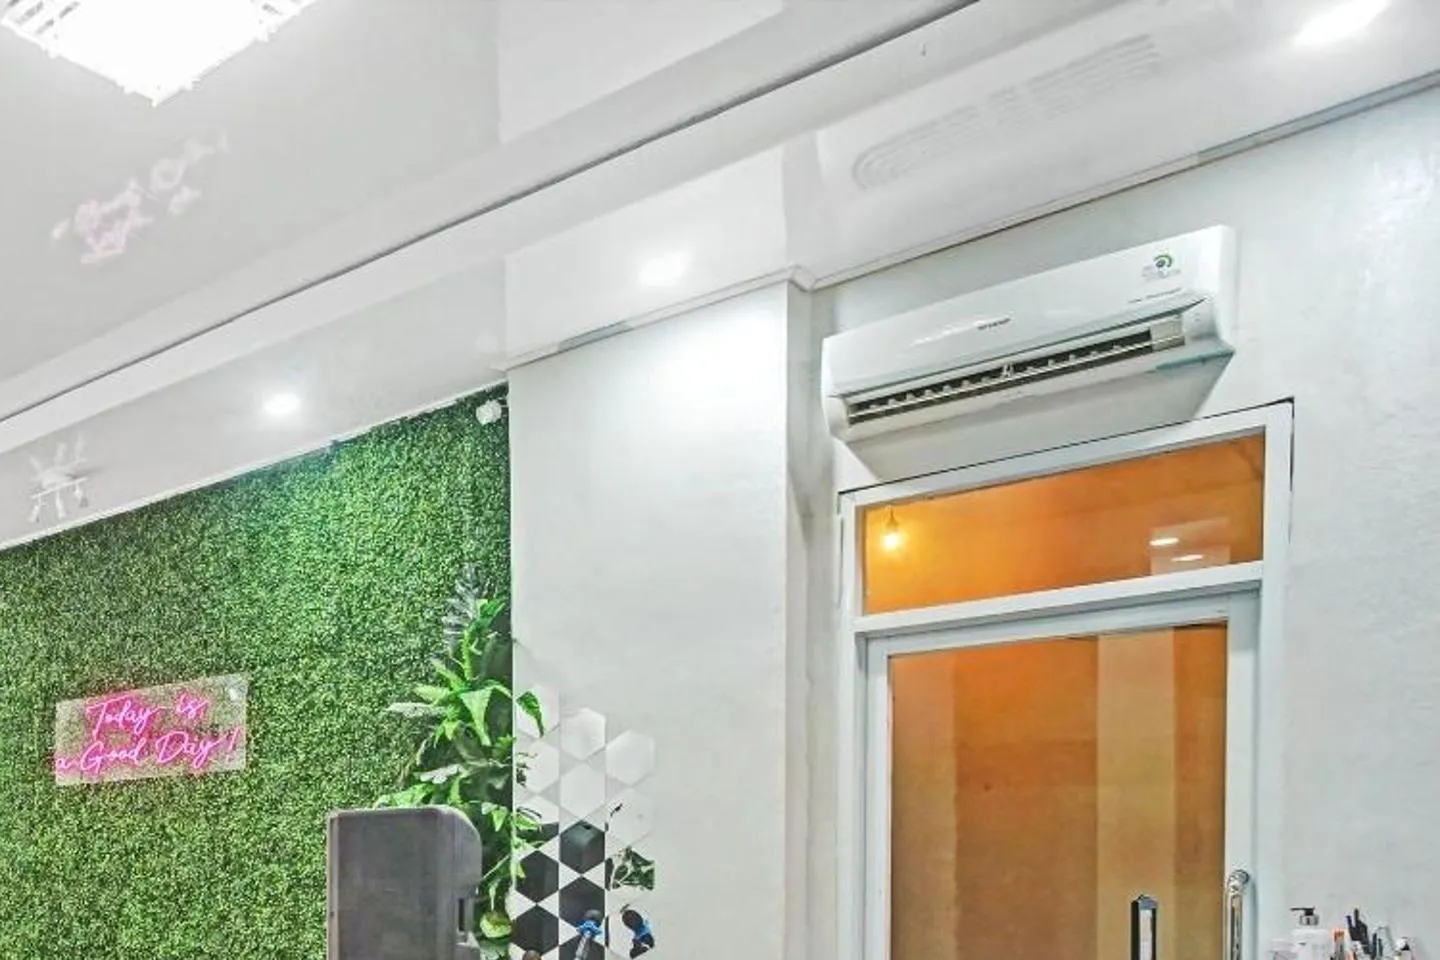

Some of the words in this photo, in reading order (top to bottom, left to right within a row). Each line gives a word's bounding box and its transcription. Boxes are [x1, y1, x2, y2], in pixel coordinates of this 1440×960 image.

[87, 694, 160, 740] Today
[177, 692, 208, 718] is
[80, 737, 147, 773] Good
